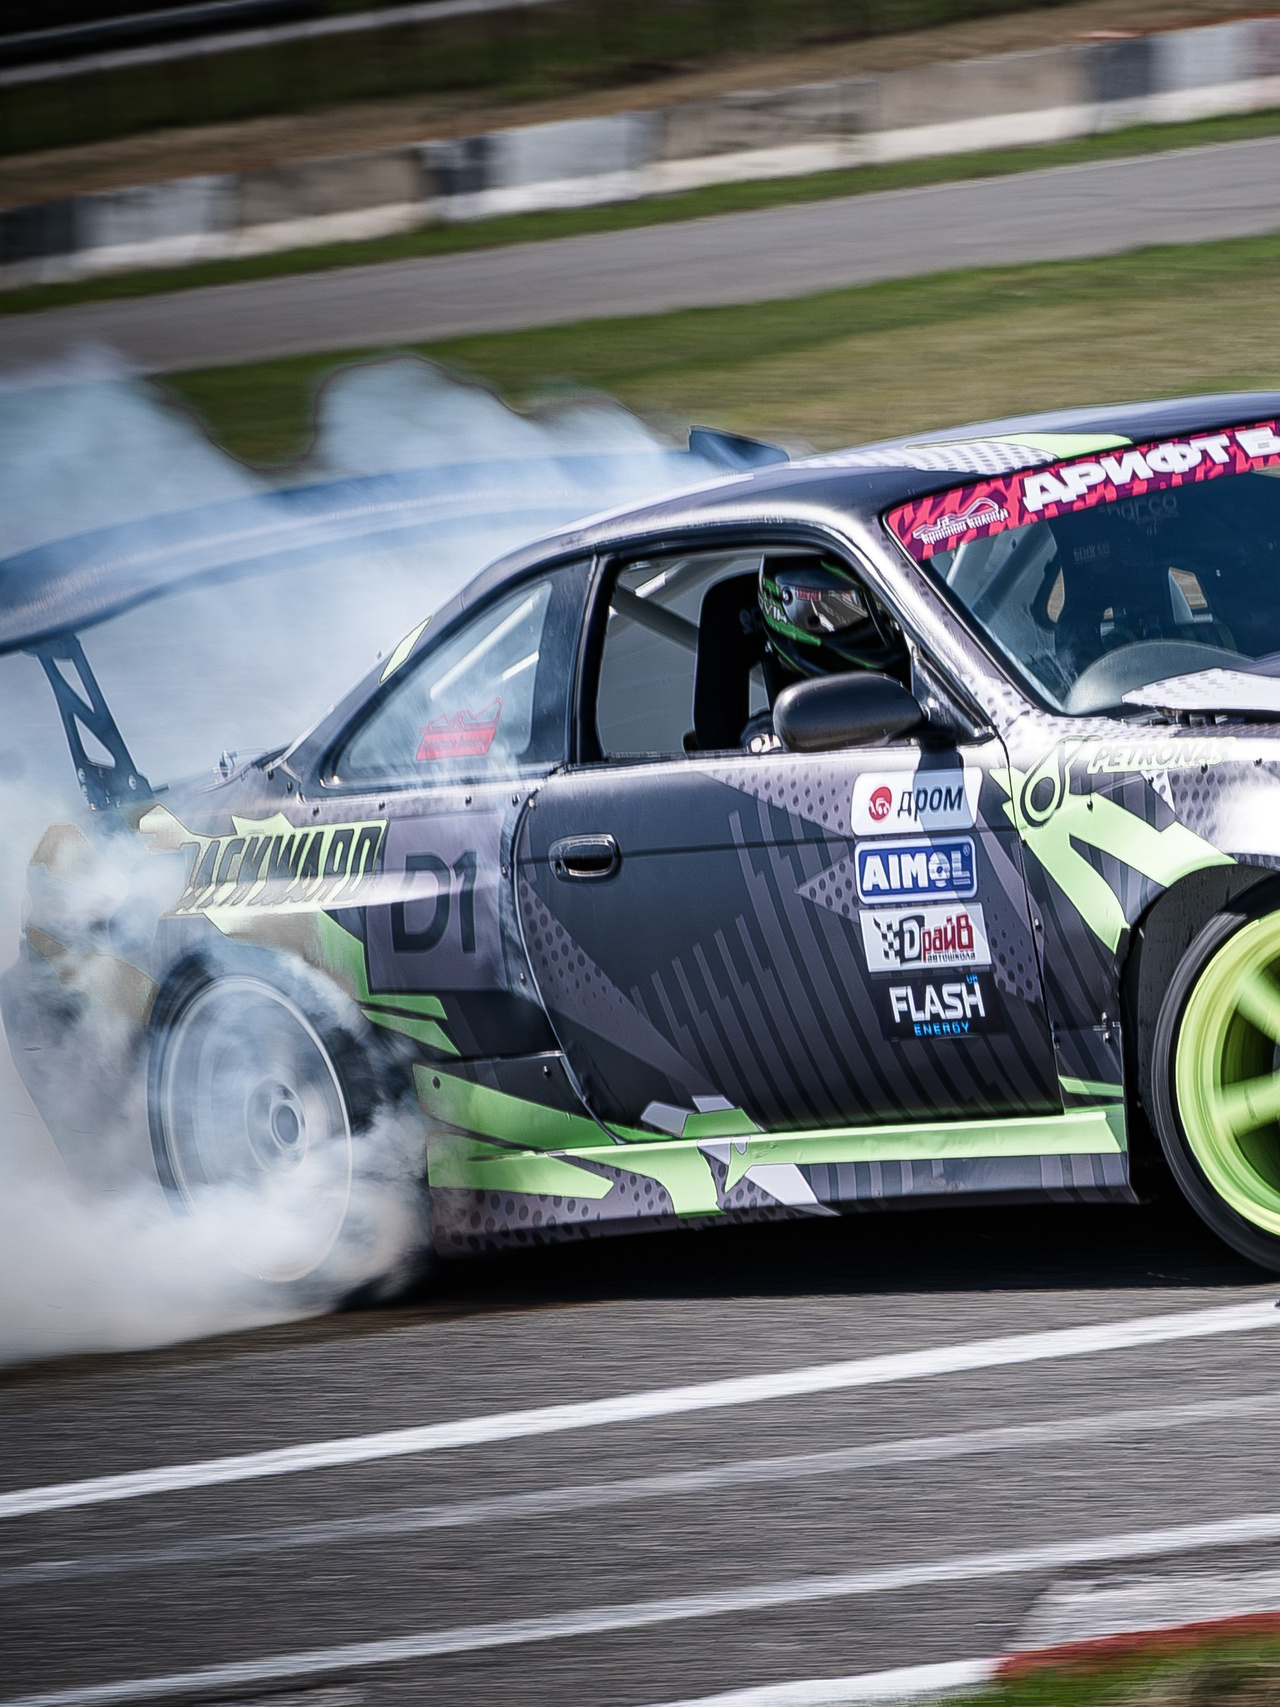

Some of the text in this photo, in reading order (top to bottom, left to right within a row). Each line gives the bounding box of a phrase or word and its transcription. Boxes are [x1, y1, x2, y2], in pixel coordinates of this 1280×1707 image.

[1023, 434, 1230, 512] ДРИФТ
[897, 784, 964, 821] дром
[862, 850, 971, 892] AIMOL
[391, 850, 479, 954] D1
[889, 982, 986, 1023] FLASH
[913, 1021, 969, 1037] ENERGY
